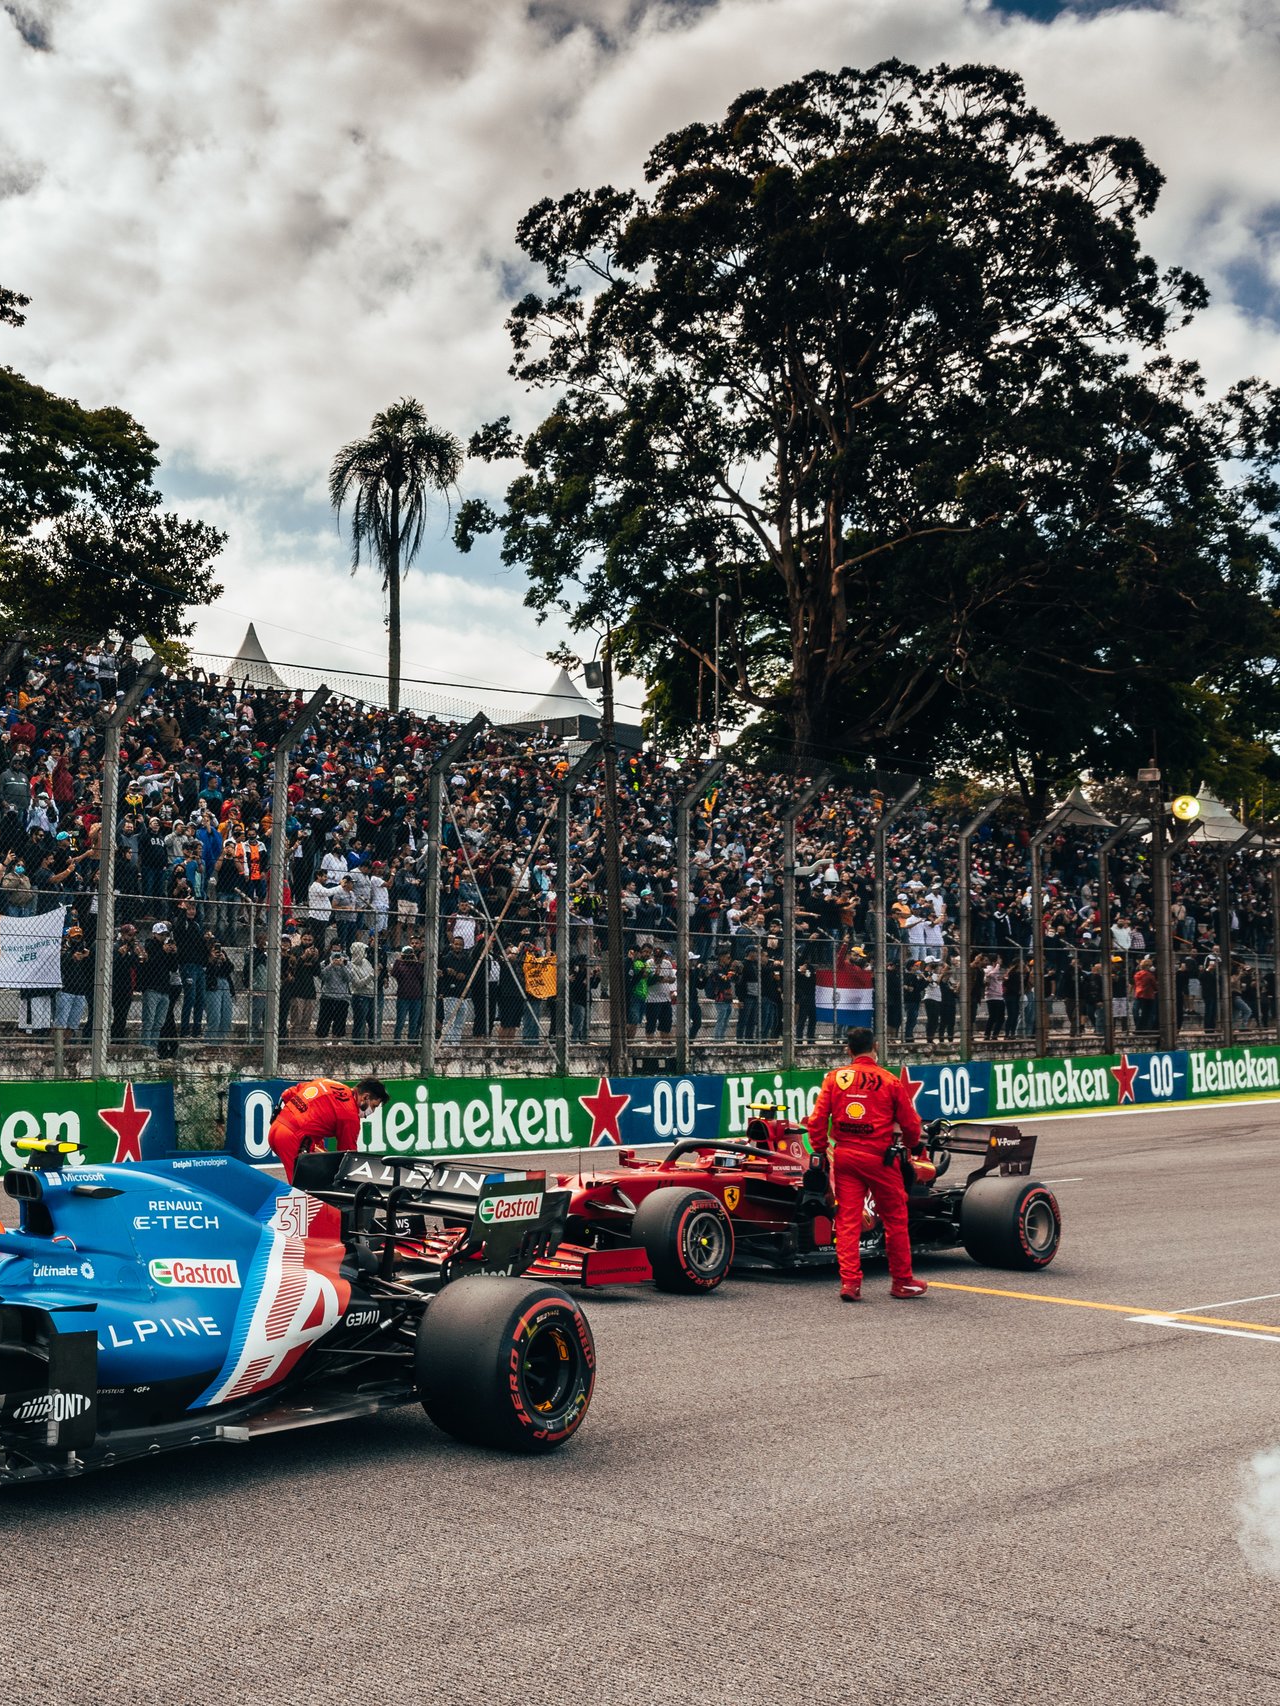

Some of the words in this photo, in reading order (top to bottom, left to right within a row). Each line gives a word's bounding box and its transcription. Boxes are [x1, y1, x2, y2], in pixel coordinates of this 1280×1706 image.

[993, 1059, 1110, 1111] Heineken
[1149, 1054, 1174, 1098] 0.0
[1190, 1050, 1280, 1093] Heineken
[653, 1079, 697, 1137] 0.0
[939, 1067, 971, 1116] 0.0
[63, 1172, 106, 1183] Microsoft
[173, 1160, 192, 1169] Delphi
[192, 1158, 228, 1168] Technologies
[348, 1161, 485, 1192] ALPIN
[149, 1200, 203, 1212] RENAULT
[276, 1196, 309, 1240] 31
[495, 1196, 540, 1220] Castrol
[395, 1218, 410, 1229] WS
[32, 1263, 78, 1278] ultimate
[173, 1261, 236, 1285] Castrol
[97, 1316, 222, 1351] LPINE
[509, 1347, 533, 1427] ZERO
